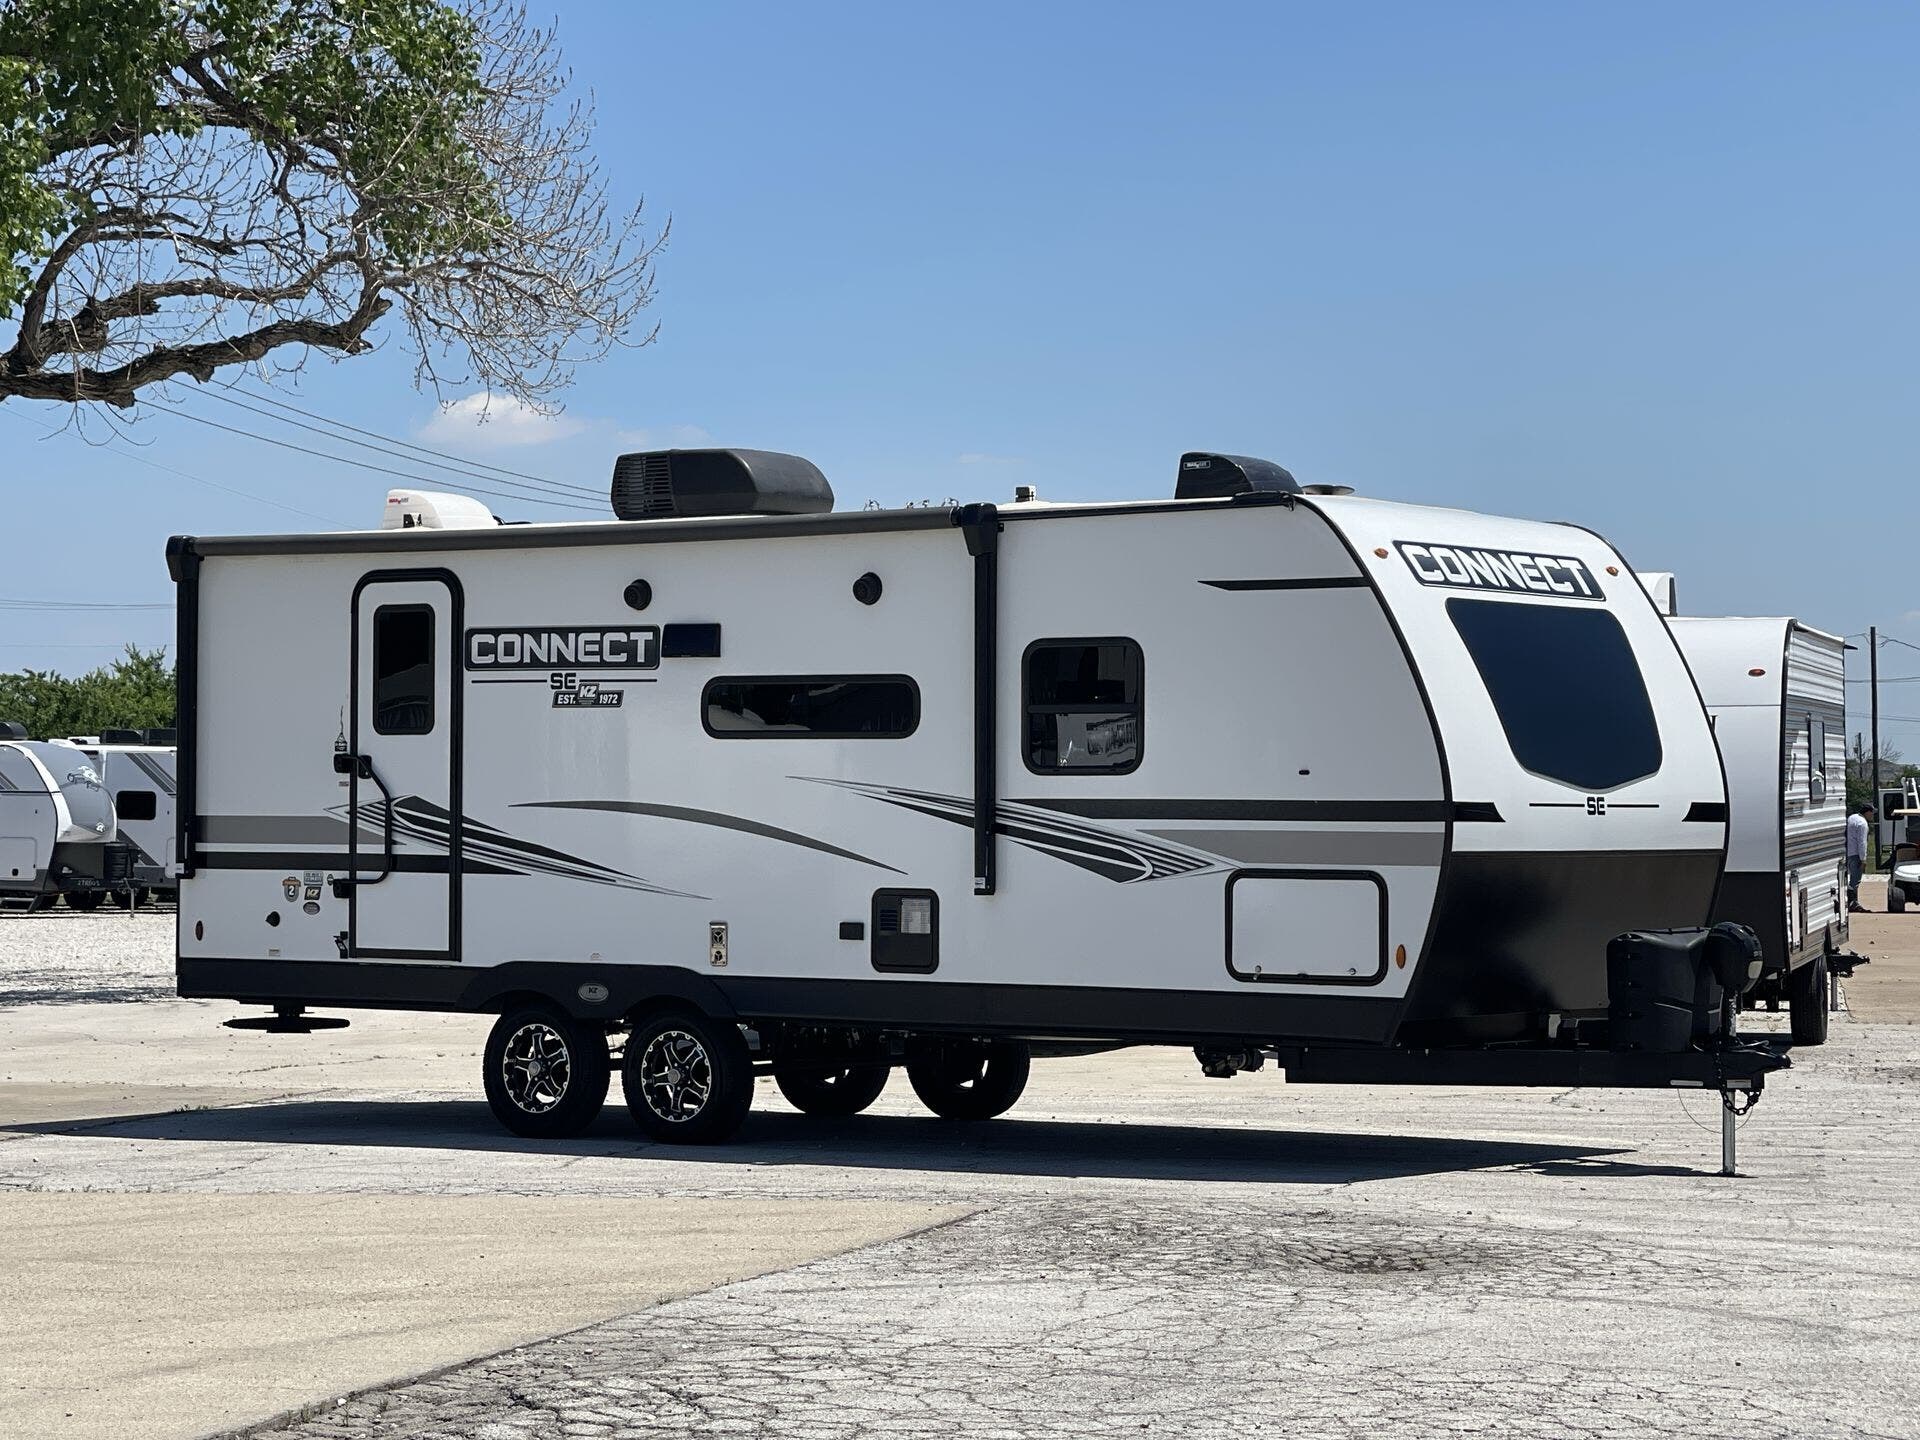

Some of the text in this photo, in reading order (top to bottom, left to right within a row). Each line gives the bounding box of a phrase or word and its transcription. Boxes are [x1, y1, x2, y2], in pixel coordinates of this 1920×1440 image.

[1401, 543, 1593, 596] CONNECT
[471, 632, 653, 663] CONNECT
[551, 672, 577, 690] SE
[557, 694, 577, 704] EST.
[599, 693, 619, 704] 1972
[580, 685, 597, 698] KZ
[1586, 796, 1606, 816] SE
